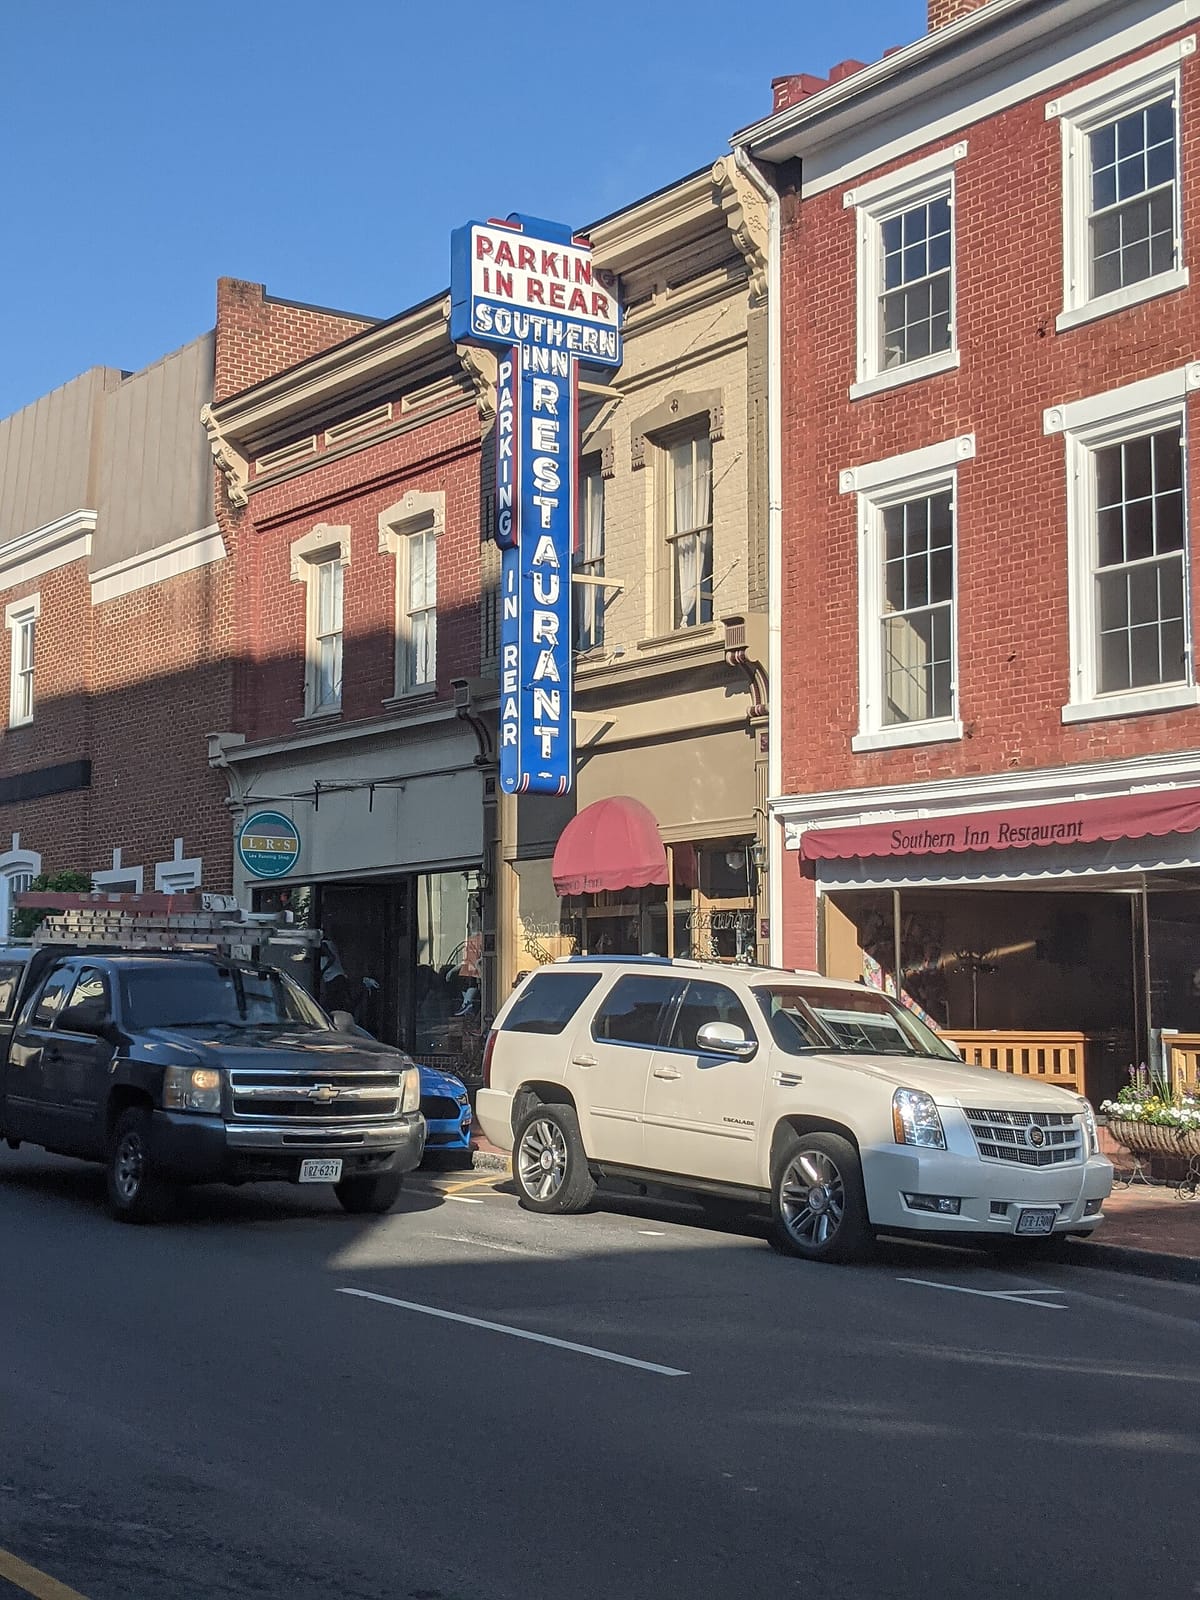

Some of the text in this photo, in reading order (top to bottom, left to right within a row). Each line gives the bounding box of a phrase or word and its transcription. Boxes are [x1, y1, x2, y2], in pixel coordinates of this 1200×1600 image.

[483, 267, 610, 320] IN REAR
[475, 303, 616, 358] SOUTHERN
[522, 344, 568, 378] INN
[499, 361, 514, 536] PARKING
[531, 378, 561, 759] RESTAURANT
[504, 570, 518, 621] IN
[503, 644, 518, 746] REAR
[890, 819, 1085, 850] Southern Inn Restaurant
[723, 1116, 755, 1127] ESCALADE
